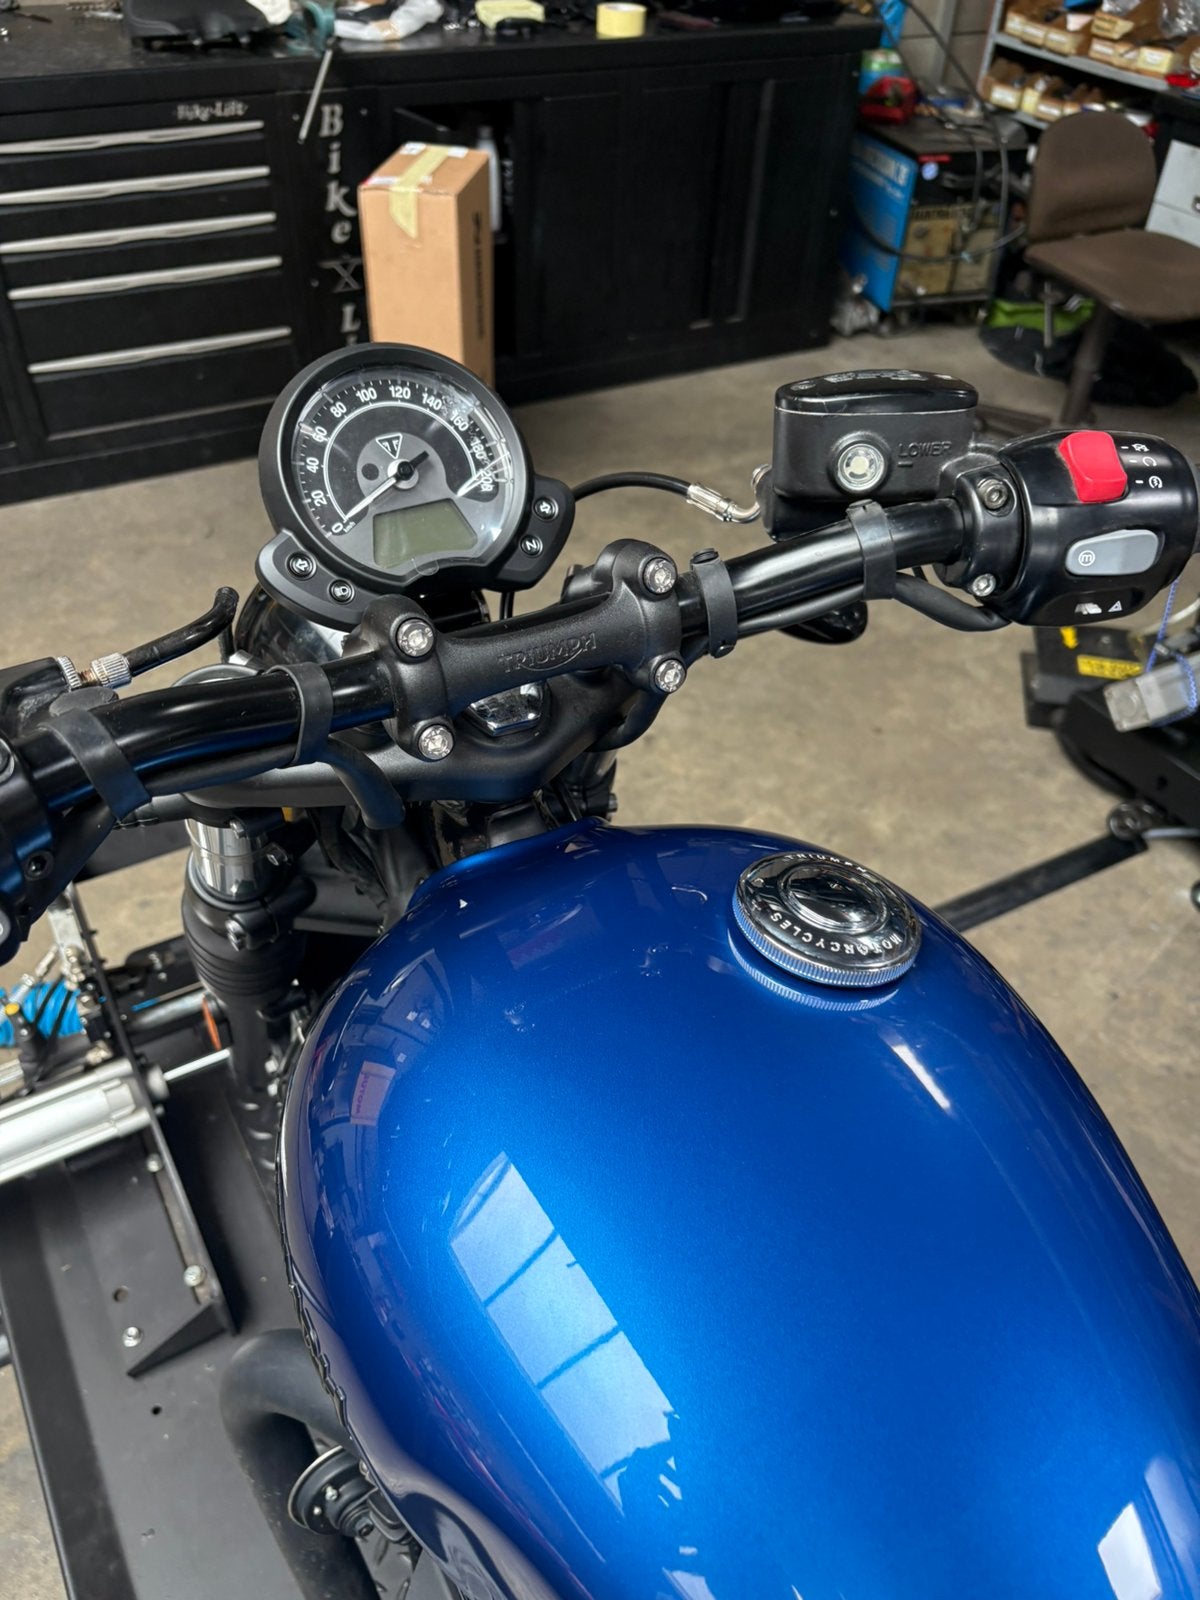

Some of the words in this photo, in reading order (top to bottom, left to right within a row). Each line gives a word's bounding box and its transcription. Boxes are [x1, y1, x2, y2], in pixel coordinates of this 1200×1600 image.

[356, 387, 378, 402] 100
[389, 386, 411, 400] 120
[330, 401, 347, 418] 80
[422, 393, 442, 411] 140
[451, 410, 469, 432] 160
[312, 426, 328, 442] 60
[470, 436, 486, 460] 180
[898, 440, 953, 458] LOWER
[306, 457, 320, 473] 40
[311, 490, 327, 507] 20
[331, 522, 344, 533] 0
[525, 539, 538, 551] N
[497, 632, 597, 673] TRIUMPH
[770, 911, 902, 955] MOTORCYCLES
